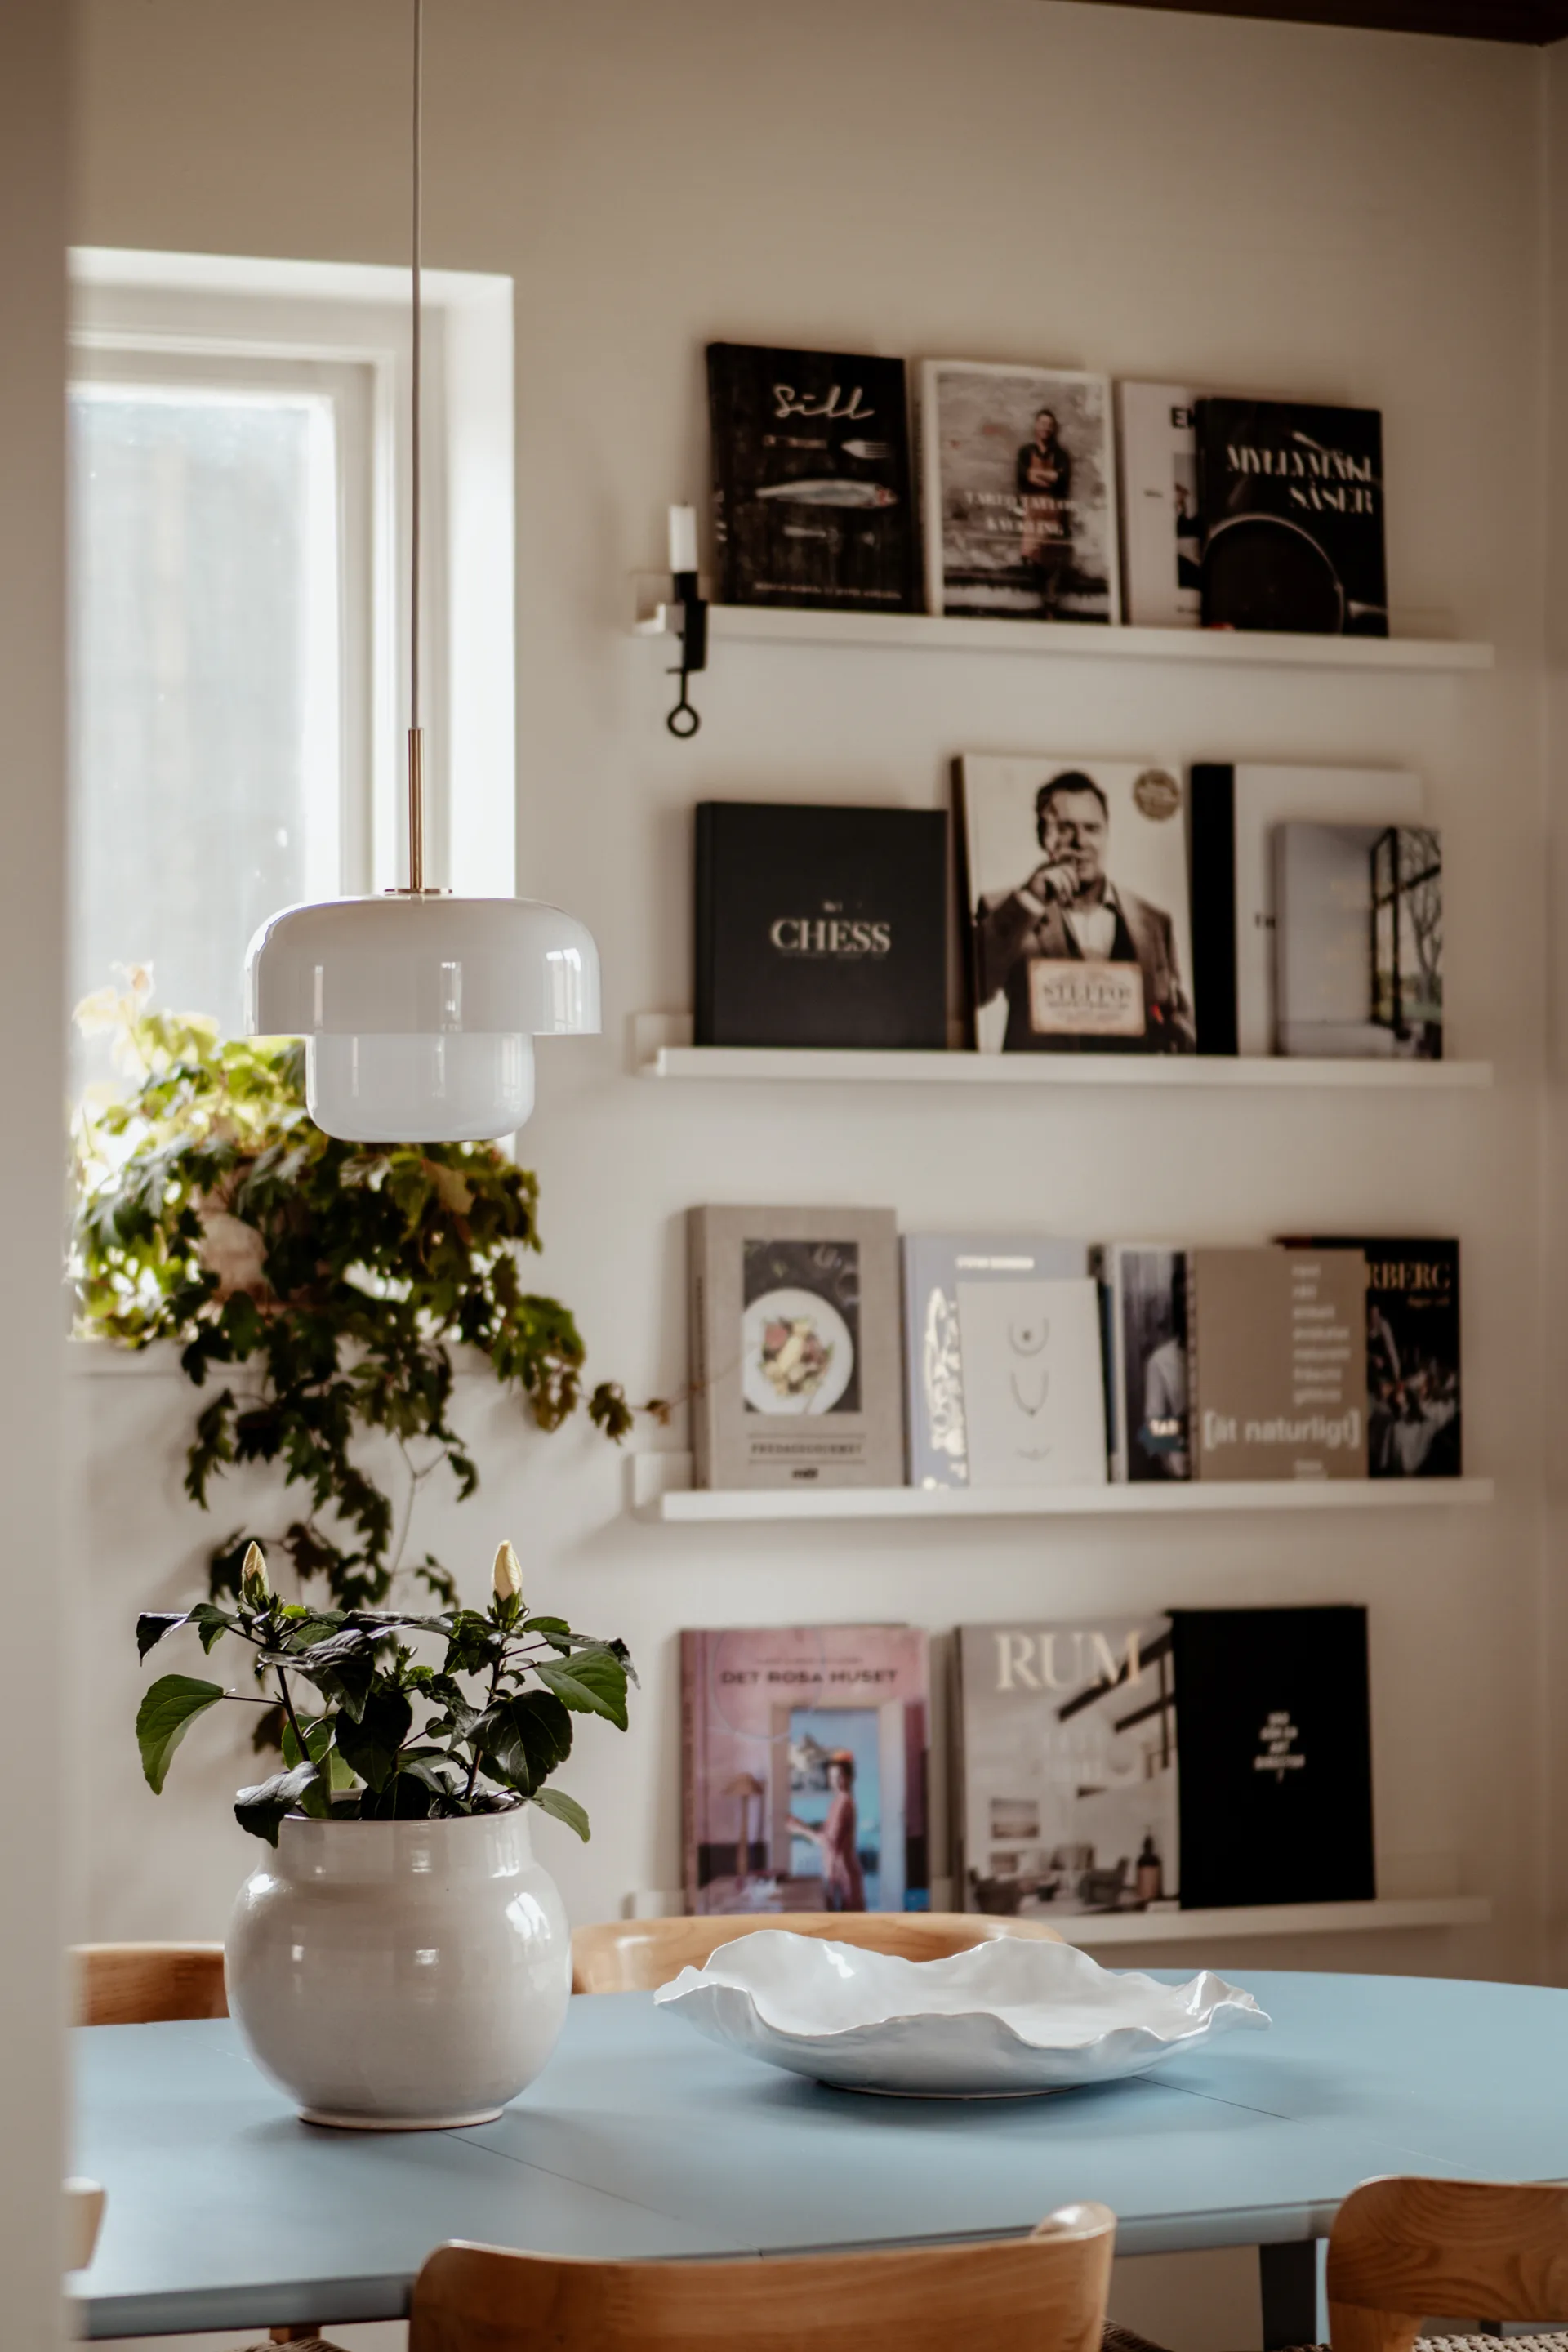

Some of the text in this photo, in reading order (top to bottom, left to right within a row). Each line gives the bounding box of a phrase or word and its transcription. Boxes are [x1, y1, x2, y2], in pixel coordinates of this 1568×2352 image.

[773, 383, 876, 421] Sill
[769, 917, 892, 953] CHESS
[719, 1668, 898, 1685] DET ROSA HUSET
[995, 1628, 1144, 1693] RUM
